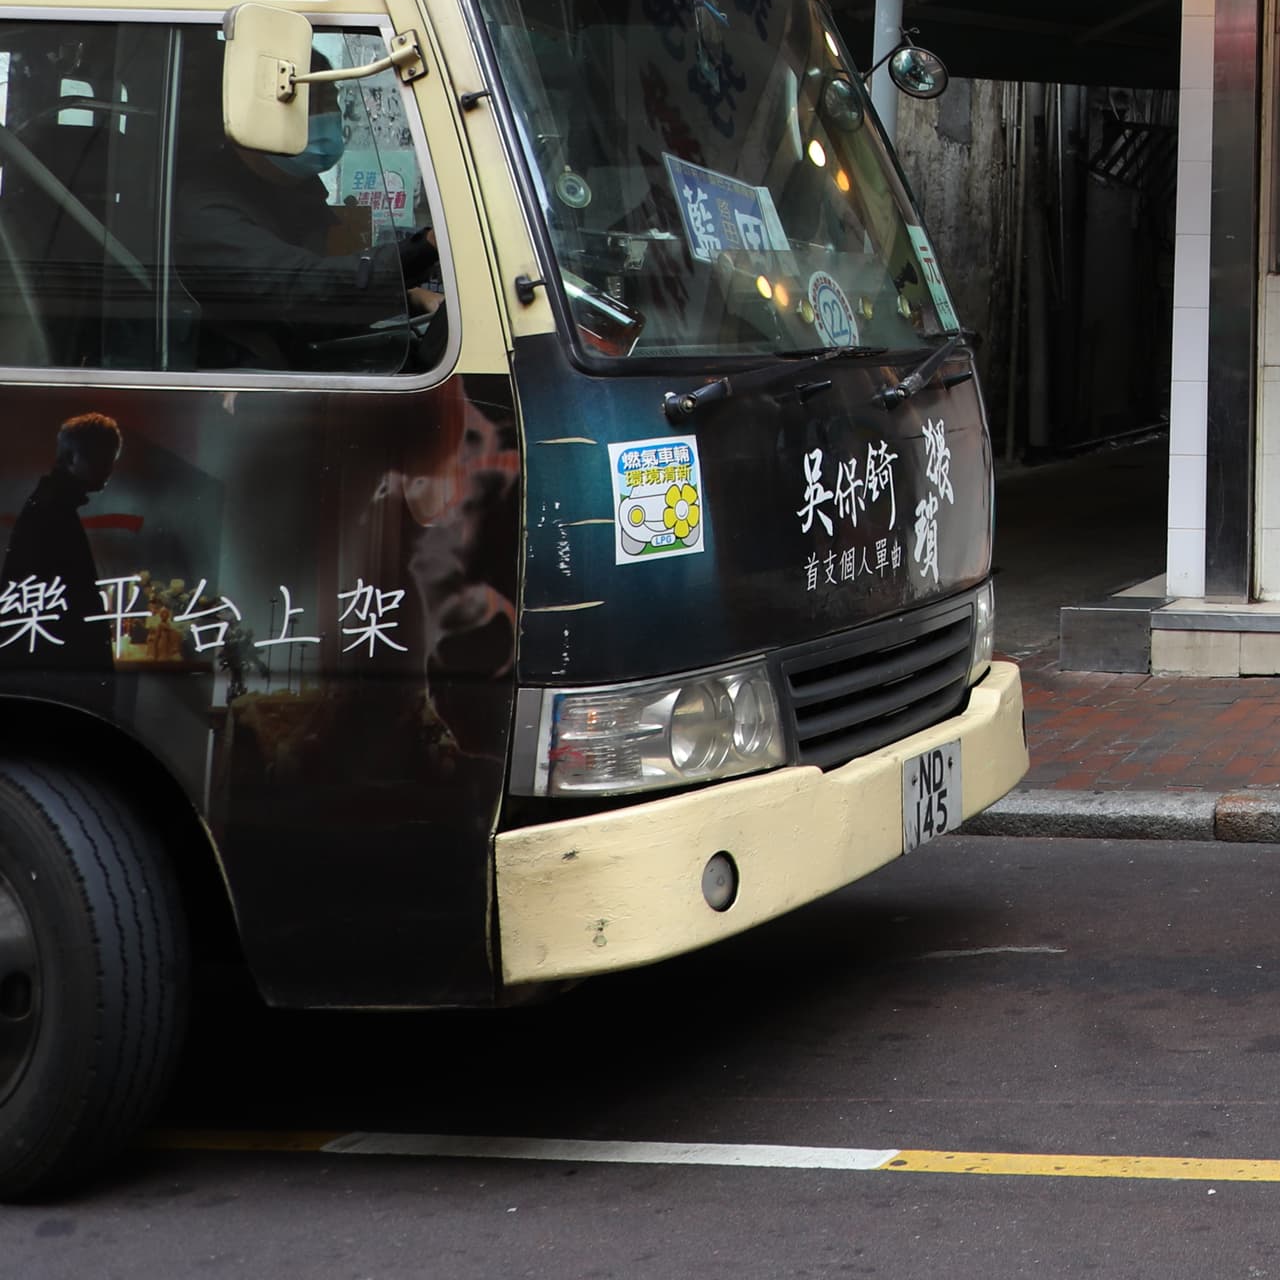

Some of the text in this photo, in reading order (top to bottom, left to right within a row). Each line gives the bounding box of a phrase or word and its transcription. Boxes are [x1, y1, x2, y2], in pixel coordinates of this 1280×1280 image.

[822, 300, 849, 339] 22
[622, 446, 690, 469] 燃氣車輛
[625, 465, 692, 487] 環境清新
[655, 535, 672, 545] LPG
[804, 537, 902, 592] 首支個人單曲
[0, 574, 409, 658] 樂平台上架
[919, 749, 944, 800] ND
